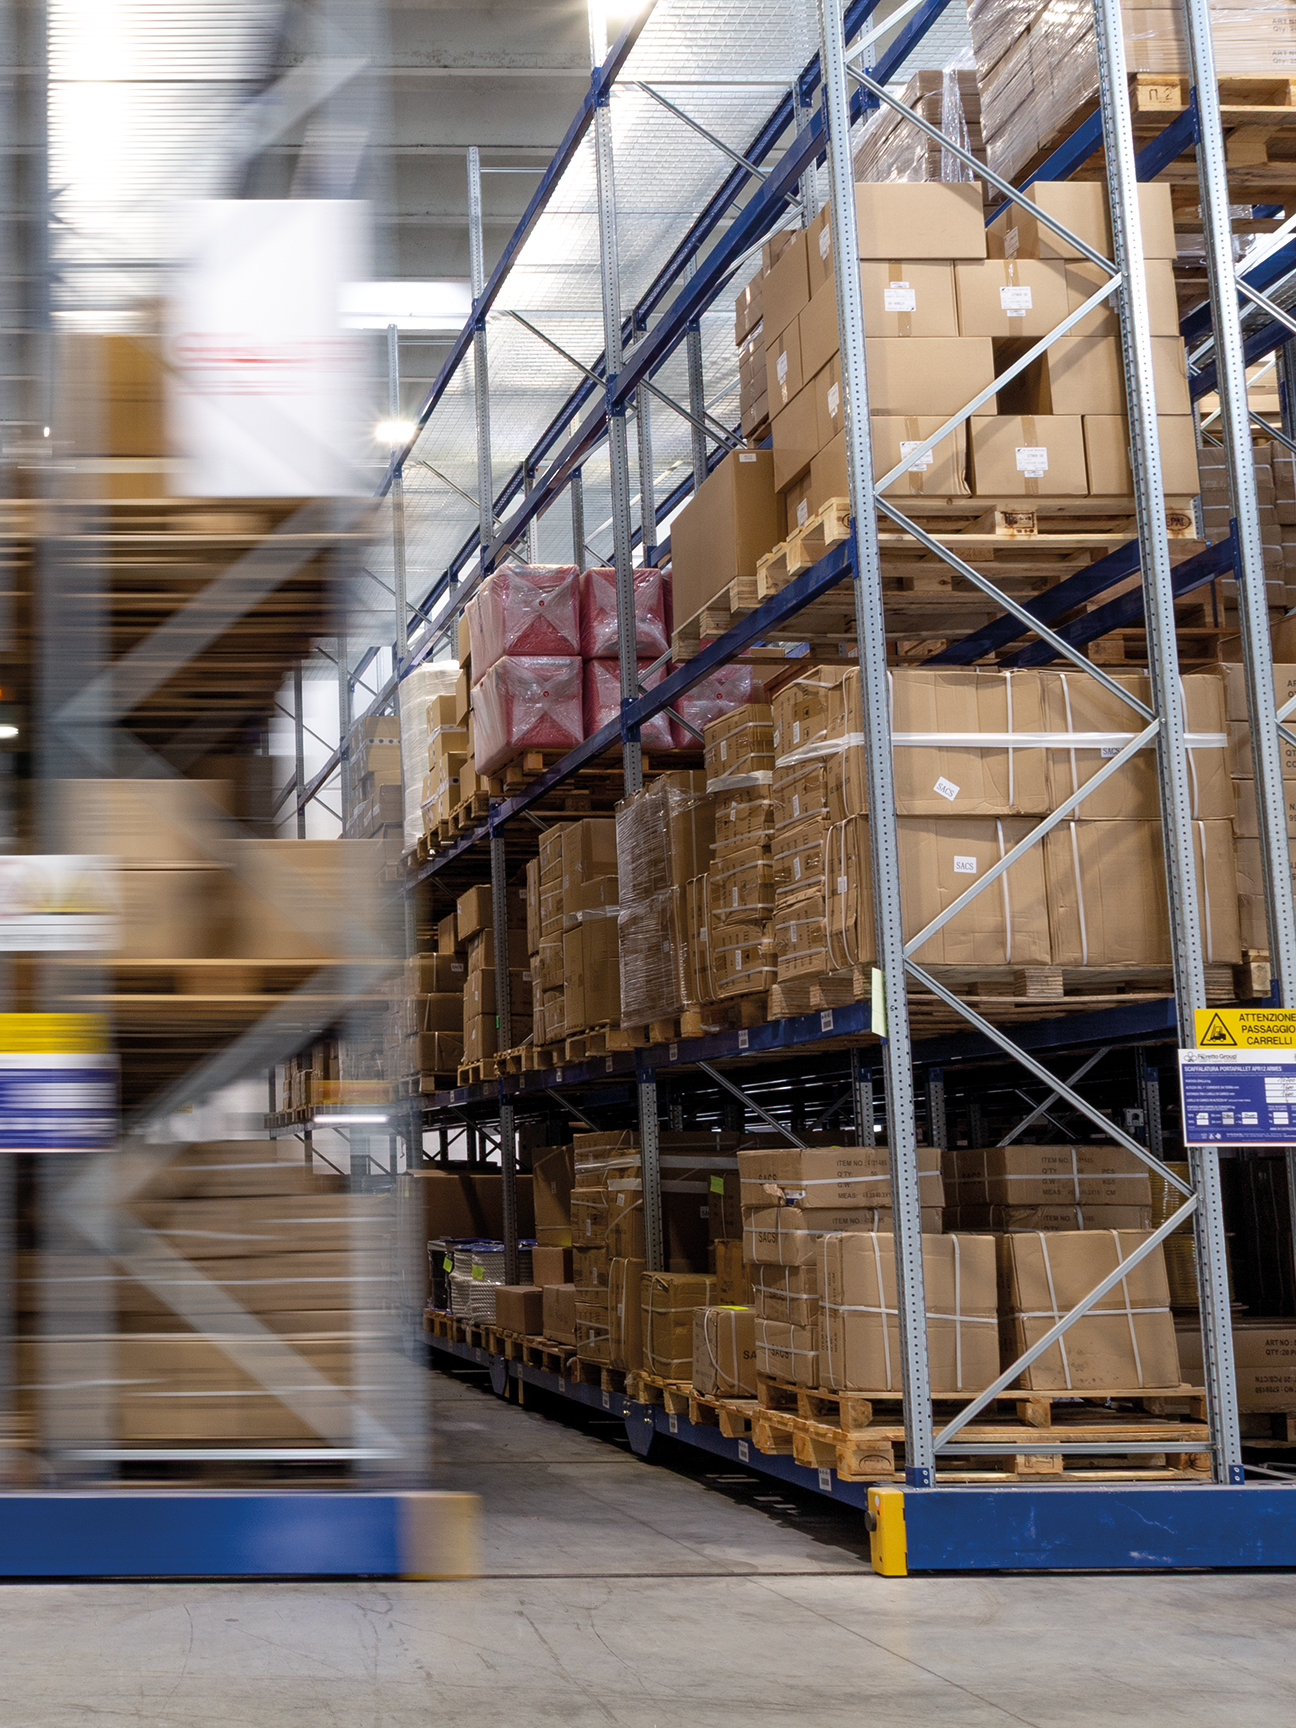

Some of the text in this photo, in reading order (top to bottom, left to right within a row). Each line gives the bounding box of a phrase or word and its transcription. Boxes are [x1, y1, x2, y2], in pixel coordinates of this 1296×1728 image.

[936, 783, 955, 797] SACS
[956, 862, 974, 871] SACS
[1239, 1013, 1296, 1022] ATTENZIONE
[1241, 1025, 1296, 1033] PASSAGGIO
[1247, 1036, 1293, 1045] CARRELLI
[759, 1232, 777, 1243] SACS
[743, 1350, 757, 1360] SA
